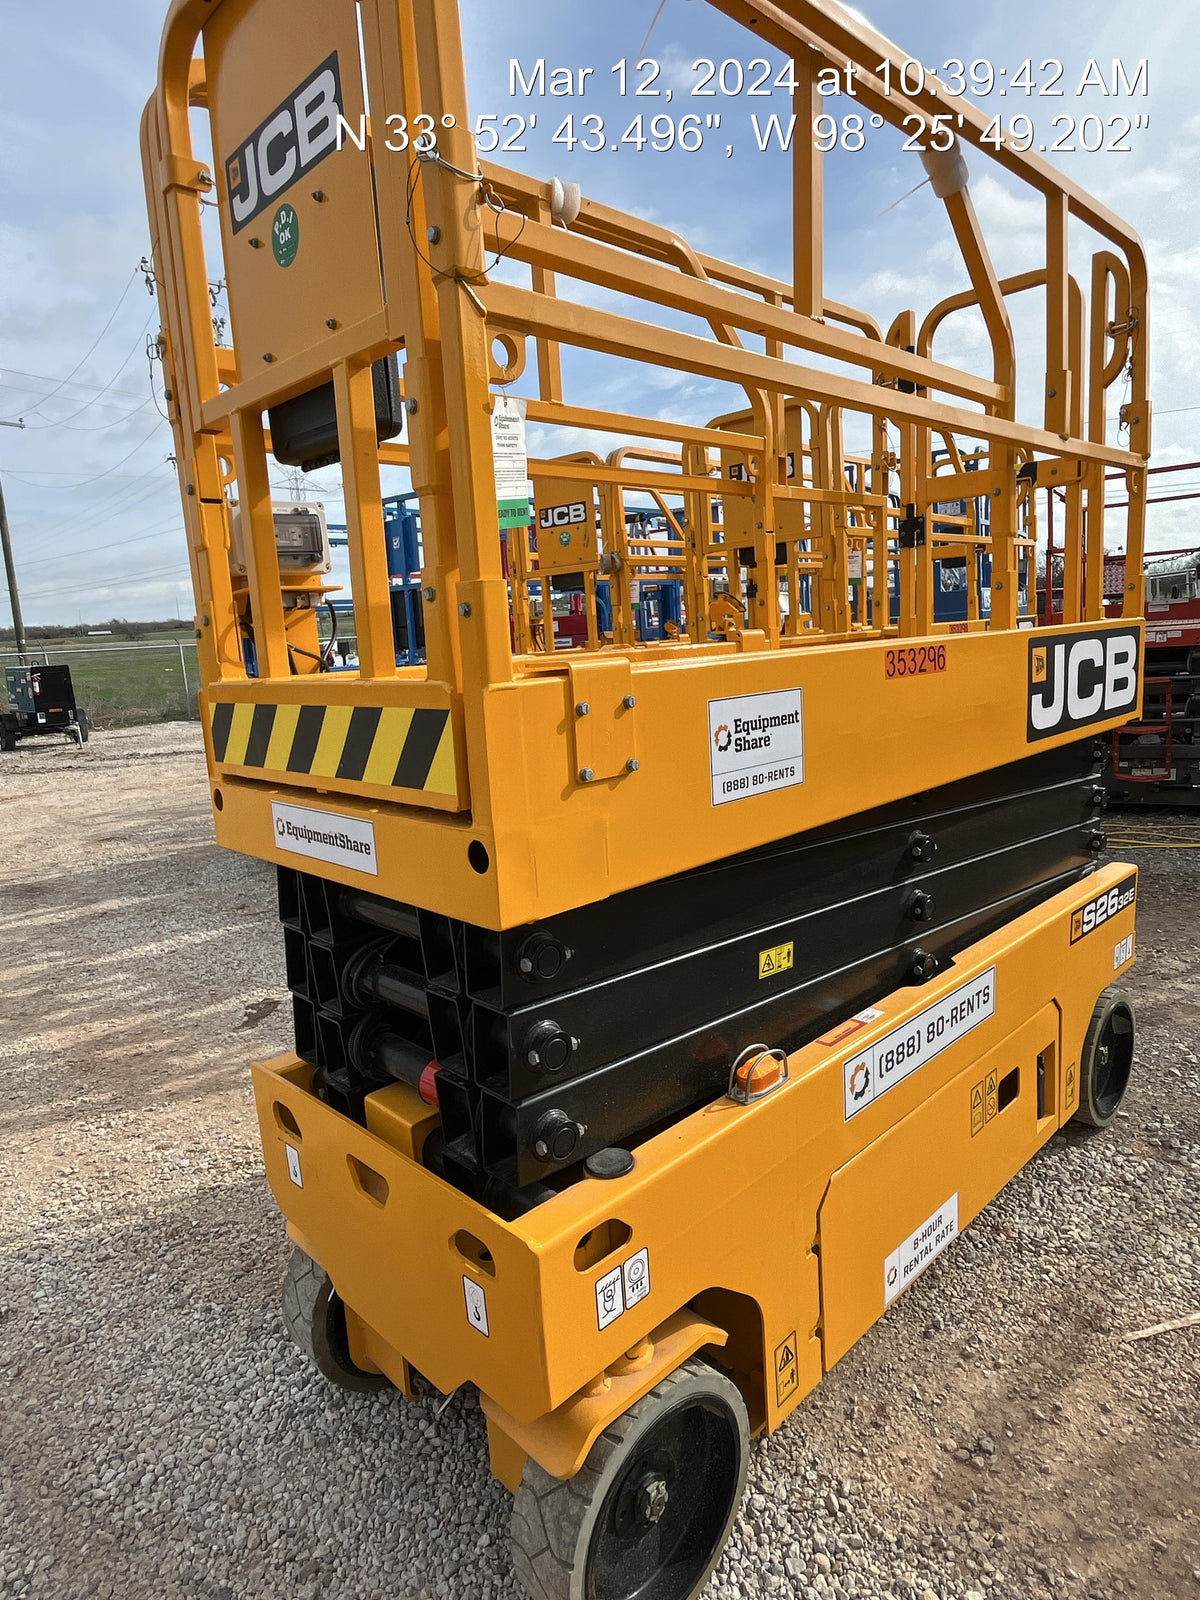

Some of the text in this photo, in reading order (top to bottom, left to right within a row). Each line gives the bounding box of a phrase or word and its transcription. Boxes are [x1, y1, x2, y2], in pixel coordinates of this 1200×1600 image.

[232, 69, 341, 222] JCB
[280, 227, 291, 245] OK
[540, 503, 586, 529] JCB
[886, 644, 947, 678] 353296
[1031, 634, 1138, 731] JCB
[733, 709, 800, 736] Equipment
[734, 735, 771, 754] Share
[722, 766, 796, 794] (888) 80-RENTS
[286, 820, 371, 856] EquipmentShare
[879, 985, 990, 1079] (888) 80-RENTS
[903, 1220, 954, 1278] RENTAL RATE
[913, 1214, 943, 1250] 8-HOUR
